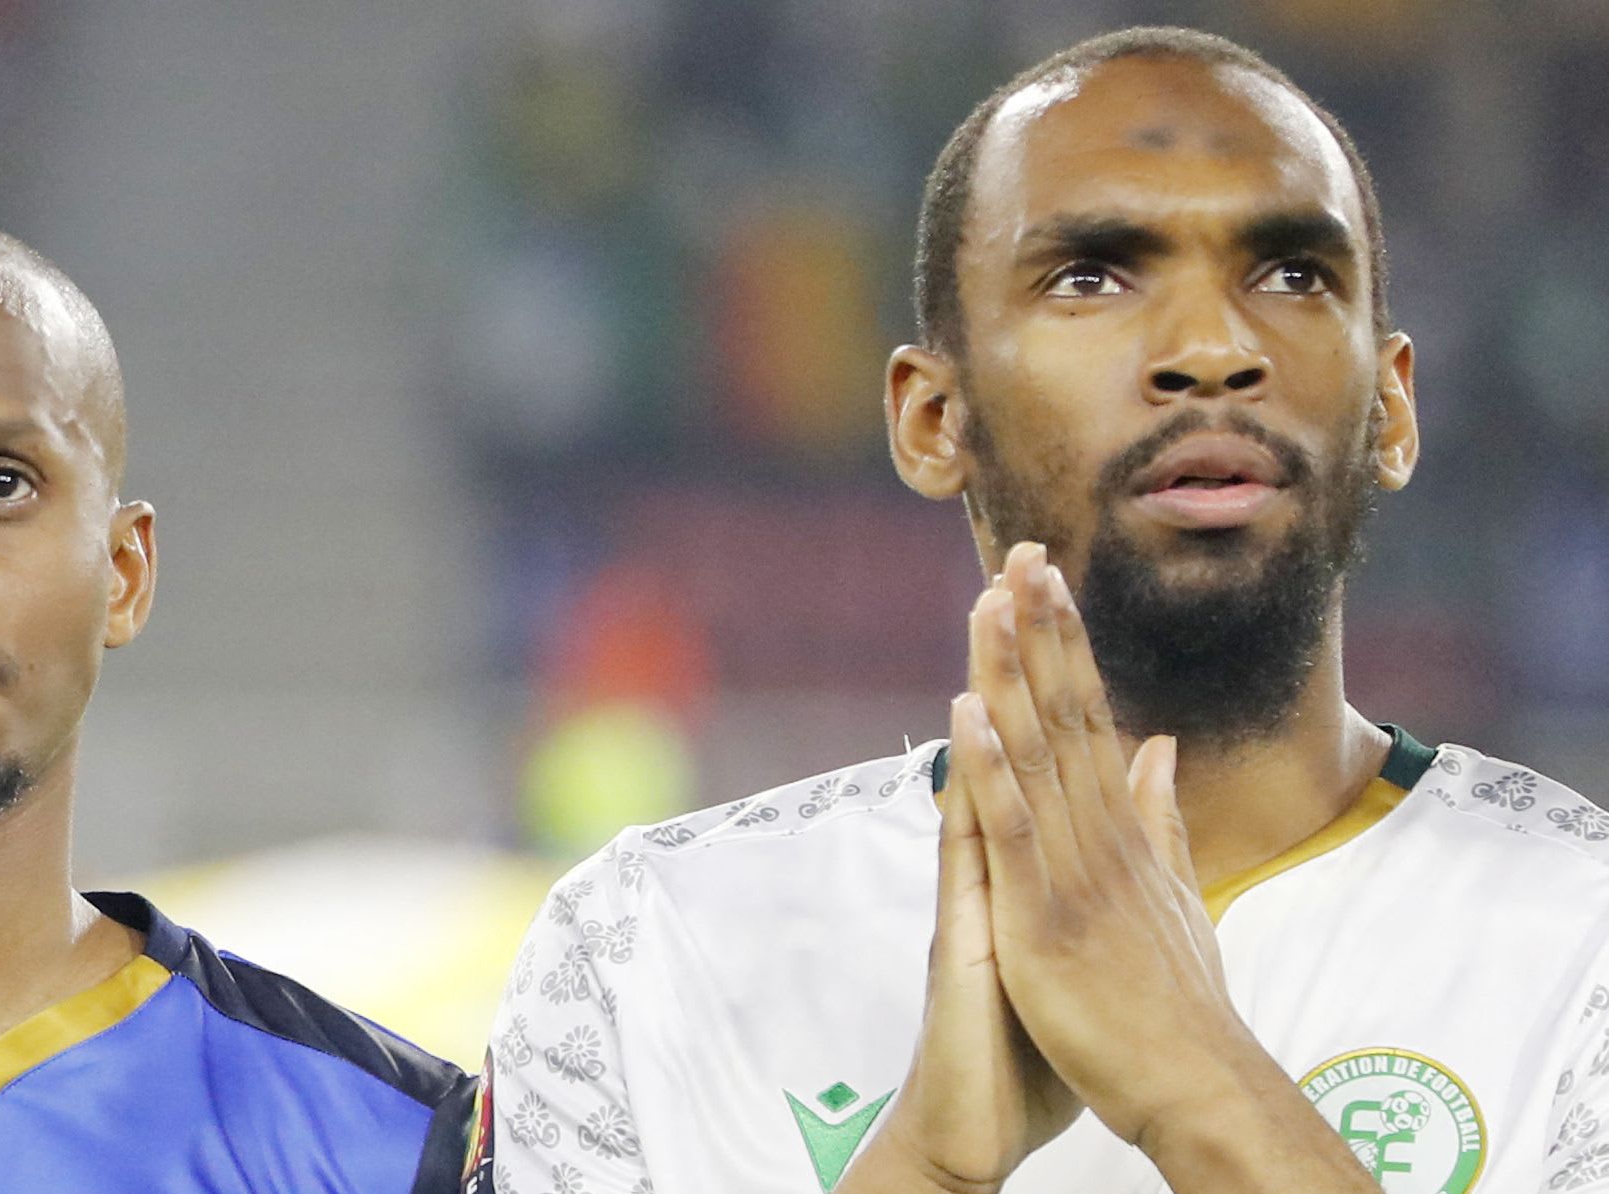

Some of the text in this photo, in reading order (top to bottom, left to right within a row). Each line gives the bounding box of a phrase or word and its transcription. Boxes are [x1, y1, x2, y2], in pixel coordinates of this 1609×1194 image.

[1301, 1056, 1482, 1152] ERATION DE FOOTBALL
